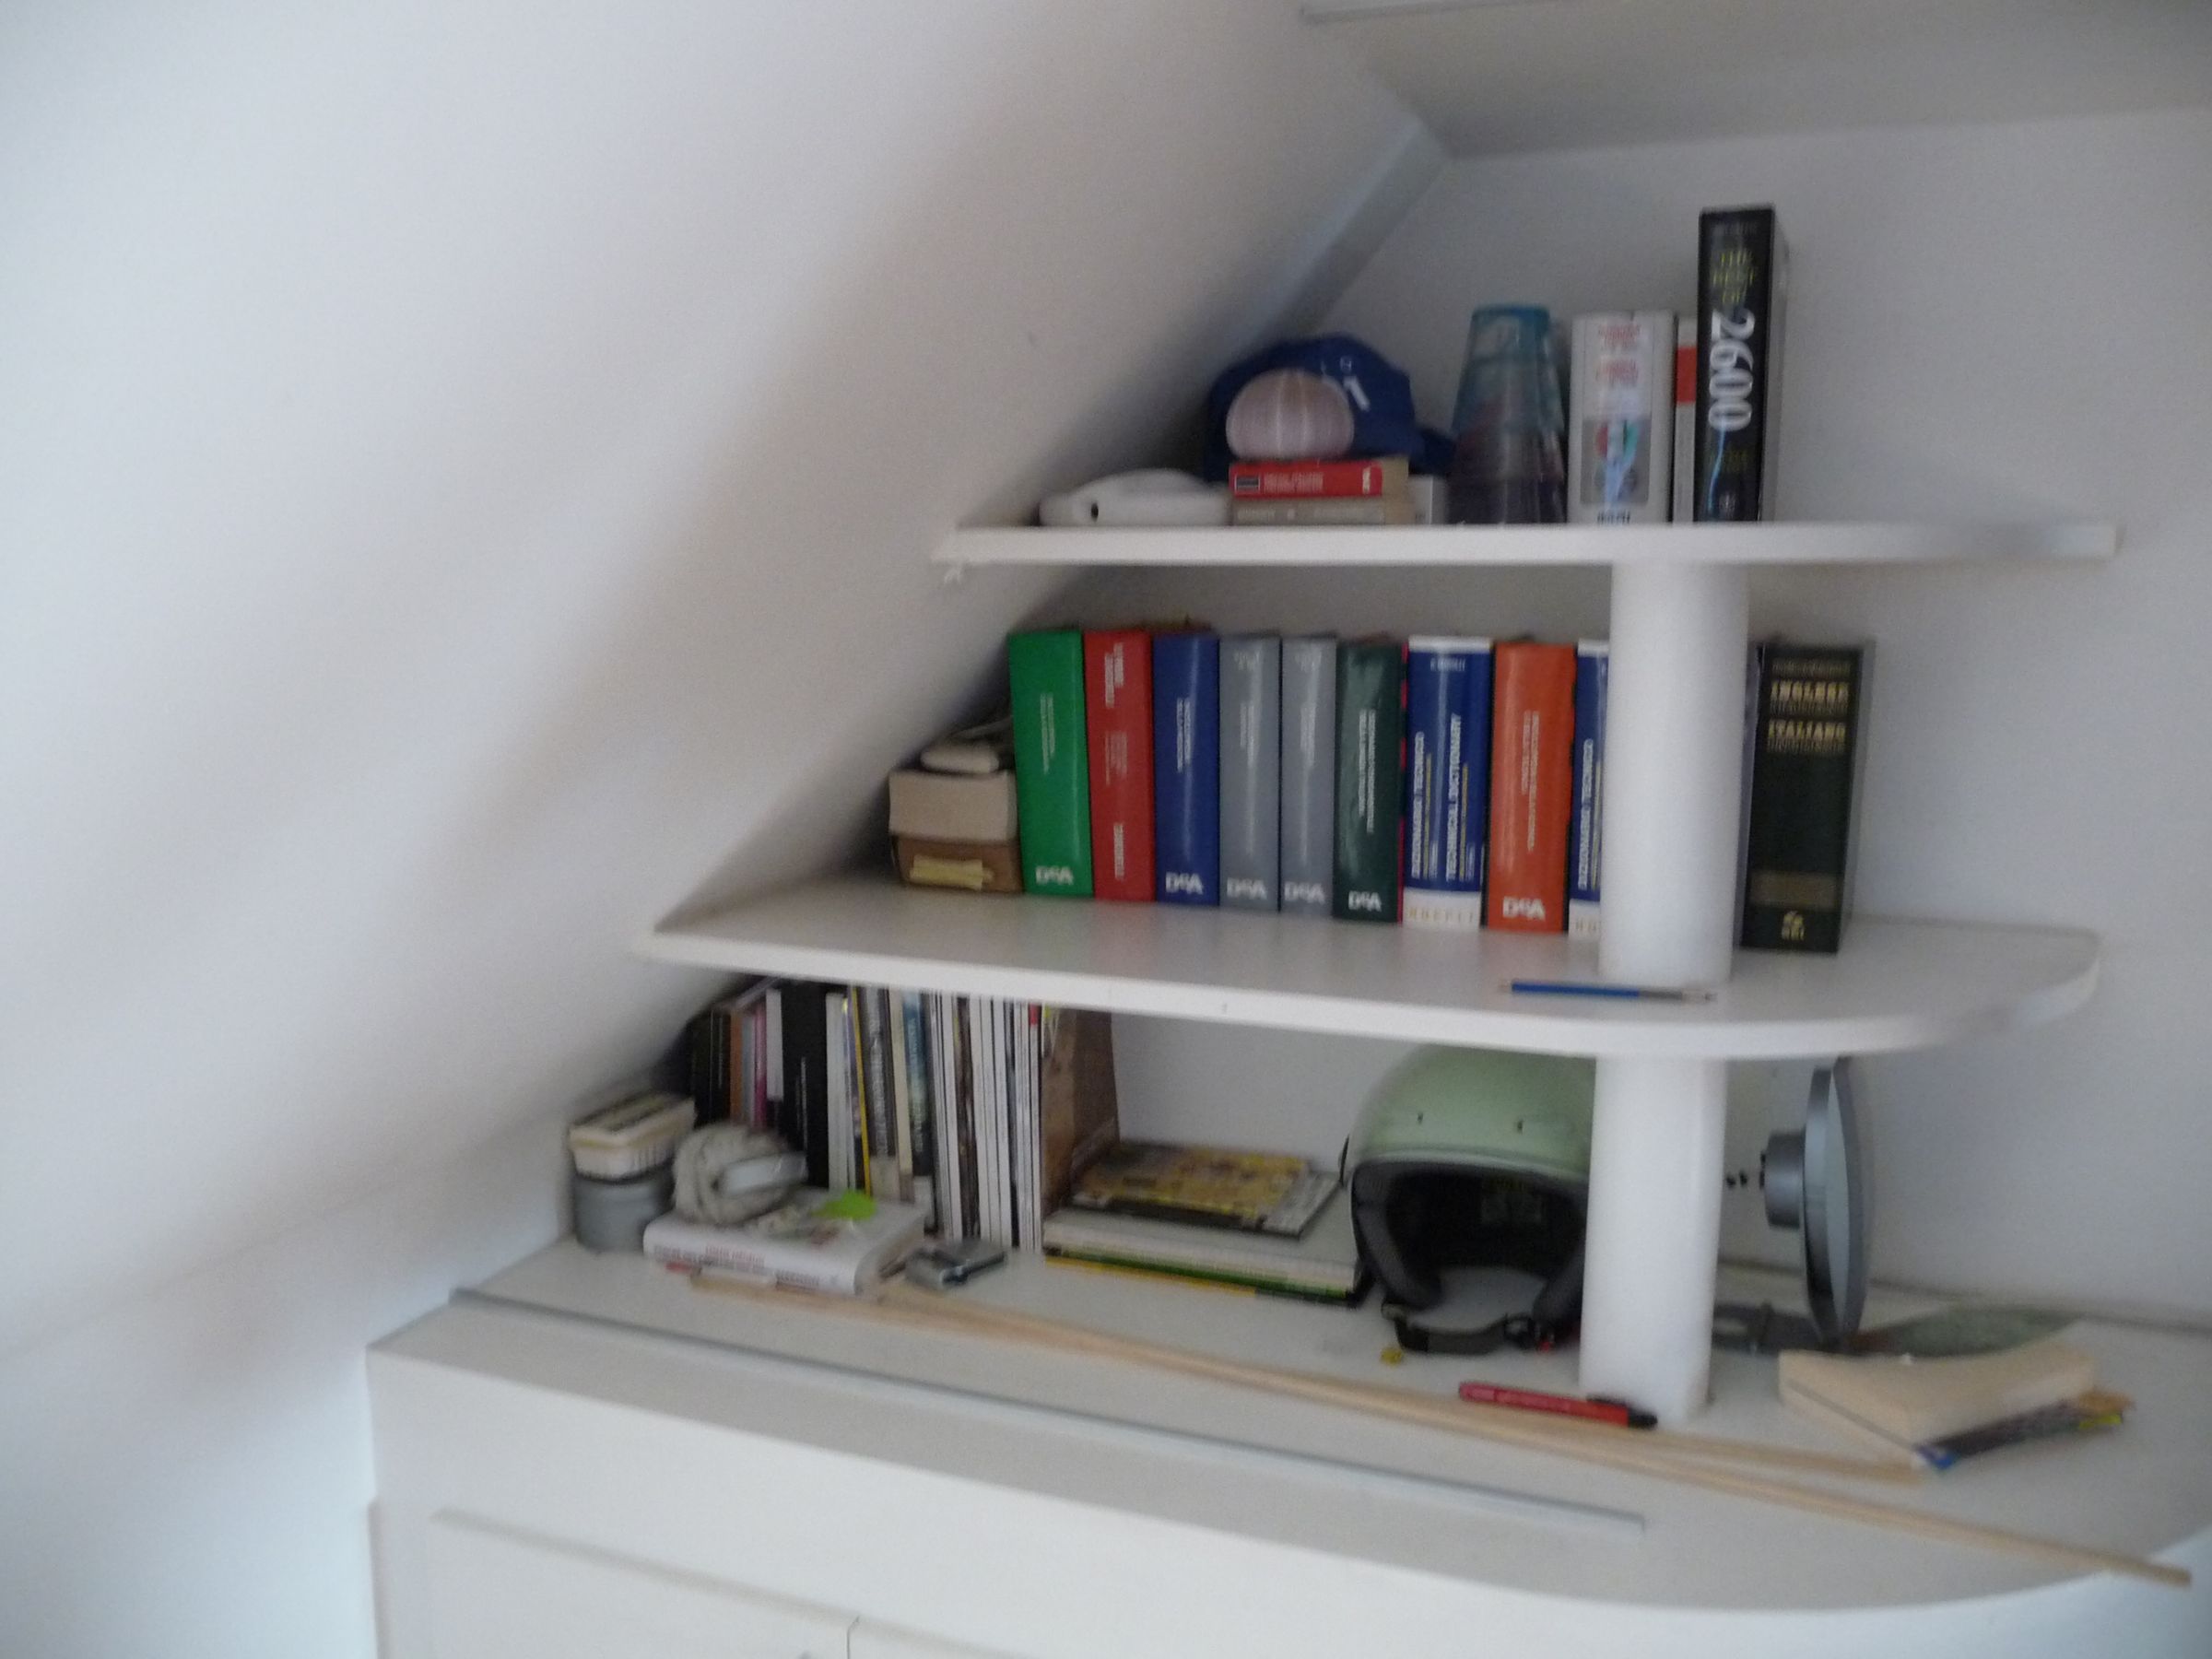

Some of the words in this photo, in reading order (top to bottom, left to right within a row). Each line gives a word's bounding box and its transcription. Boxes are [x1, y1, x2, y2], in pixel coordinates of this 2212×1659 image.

[1709, 308, 1755, 431] 2600
[1771, 680, 1849, 701] INGLESE
[1768, 719, 1846, 739] ITALIANO
